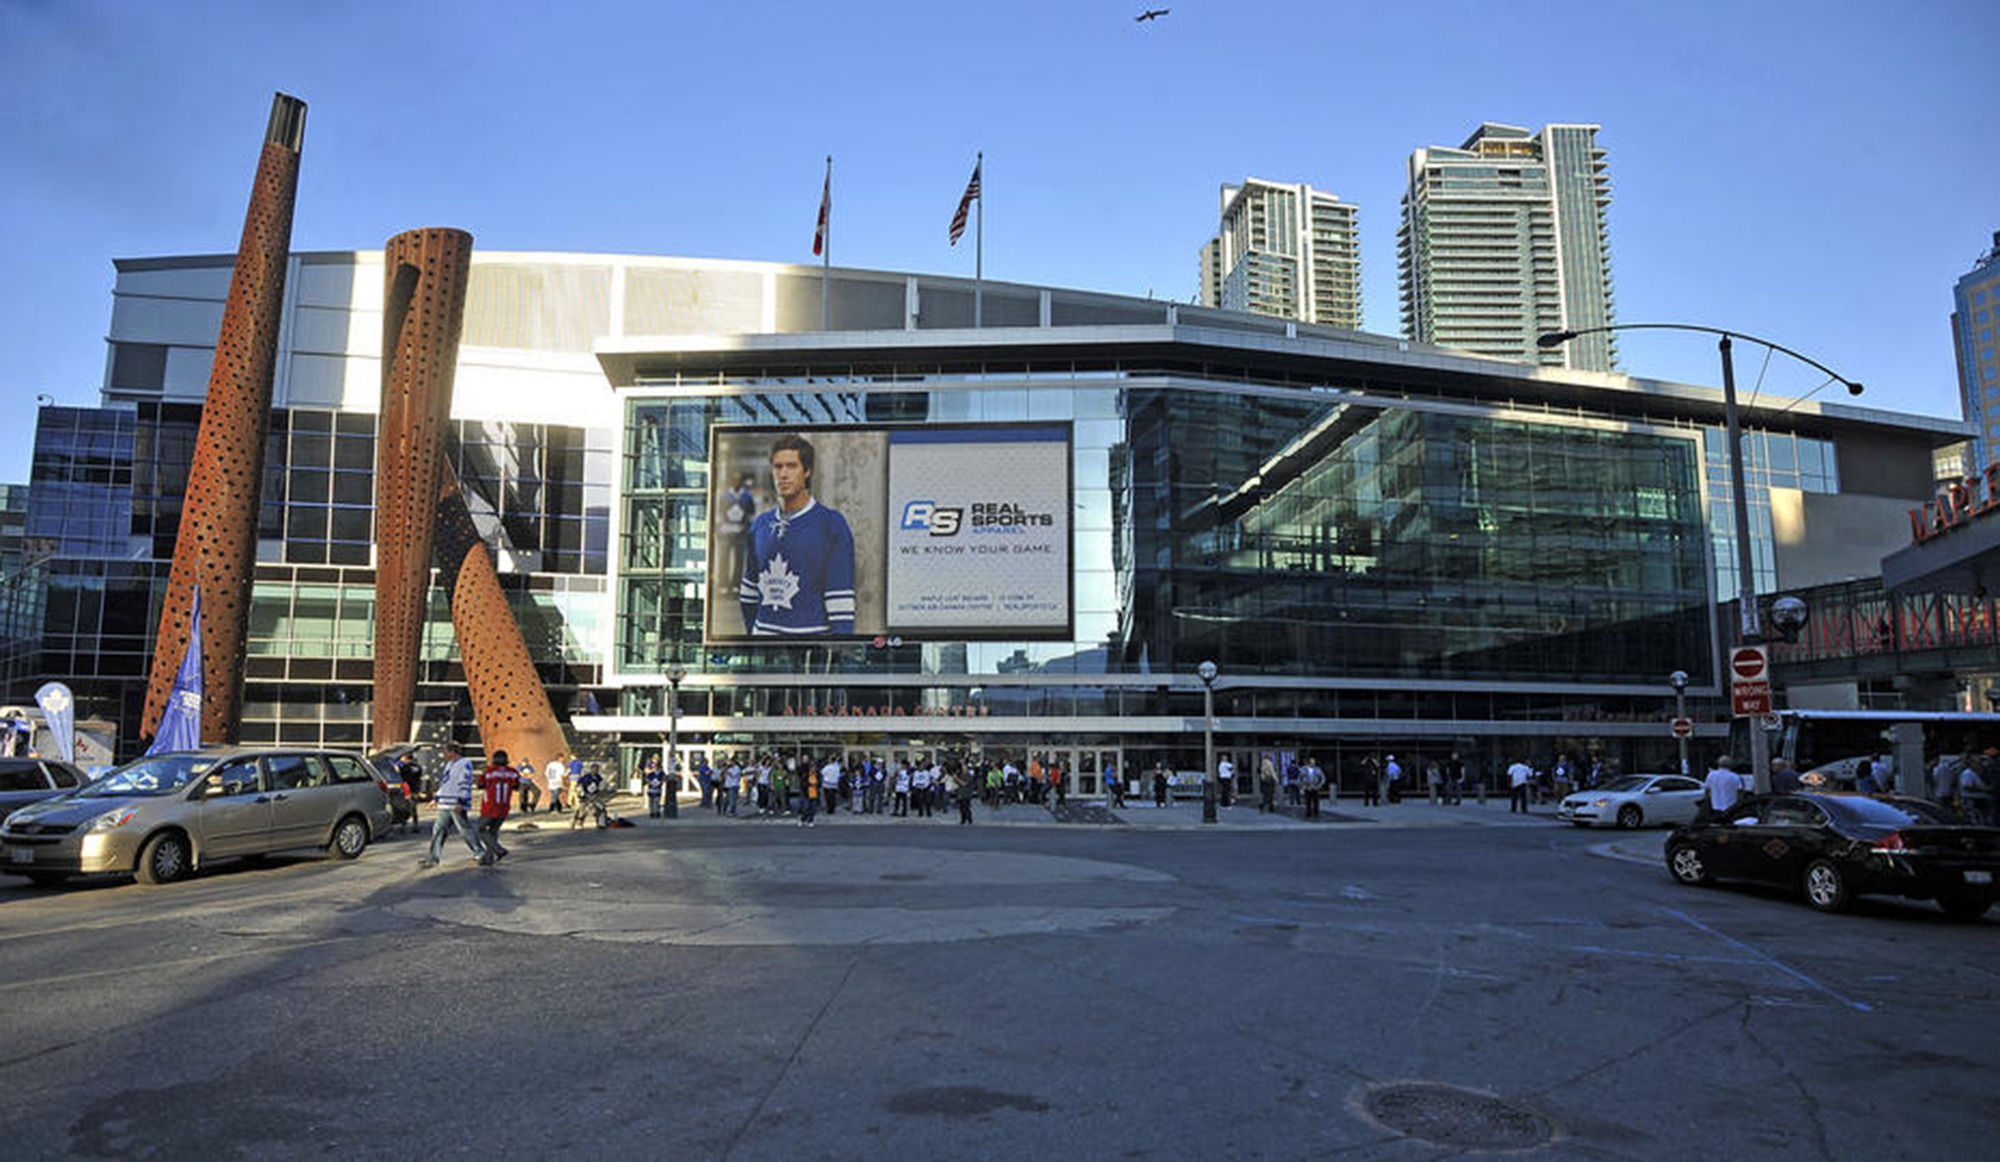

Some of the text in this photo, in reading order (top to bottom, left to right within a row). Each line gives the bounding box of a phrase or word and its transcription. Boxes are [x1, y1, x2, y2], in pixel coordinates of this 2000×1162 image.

[971, 502, 1024, 514] REAL
[971, 513, 1053, 526] SPORTS
[900, 545, 919, 555] WE
[924, 544, 964, 555] KNOW
[969, 544, 1009, 555] YOUR
[784, 705, 816, 717] AIR
[825, 705, 905, 717] CANADA
